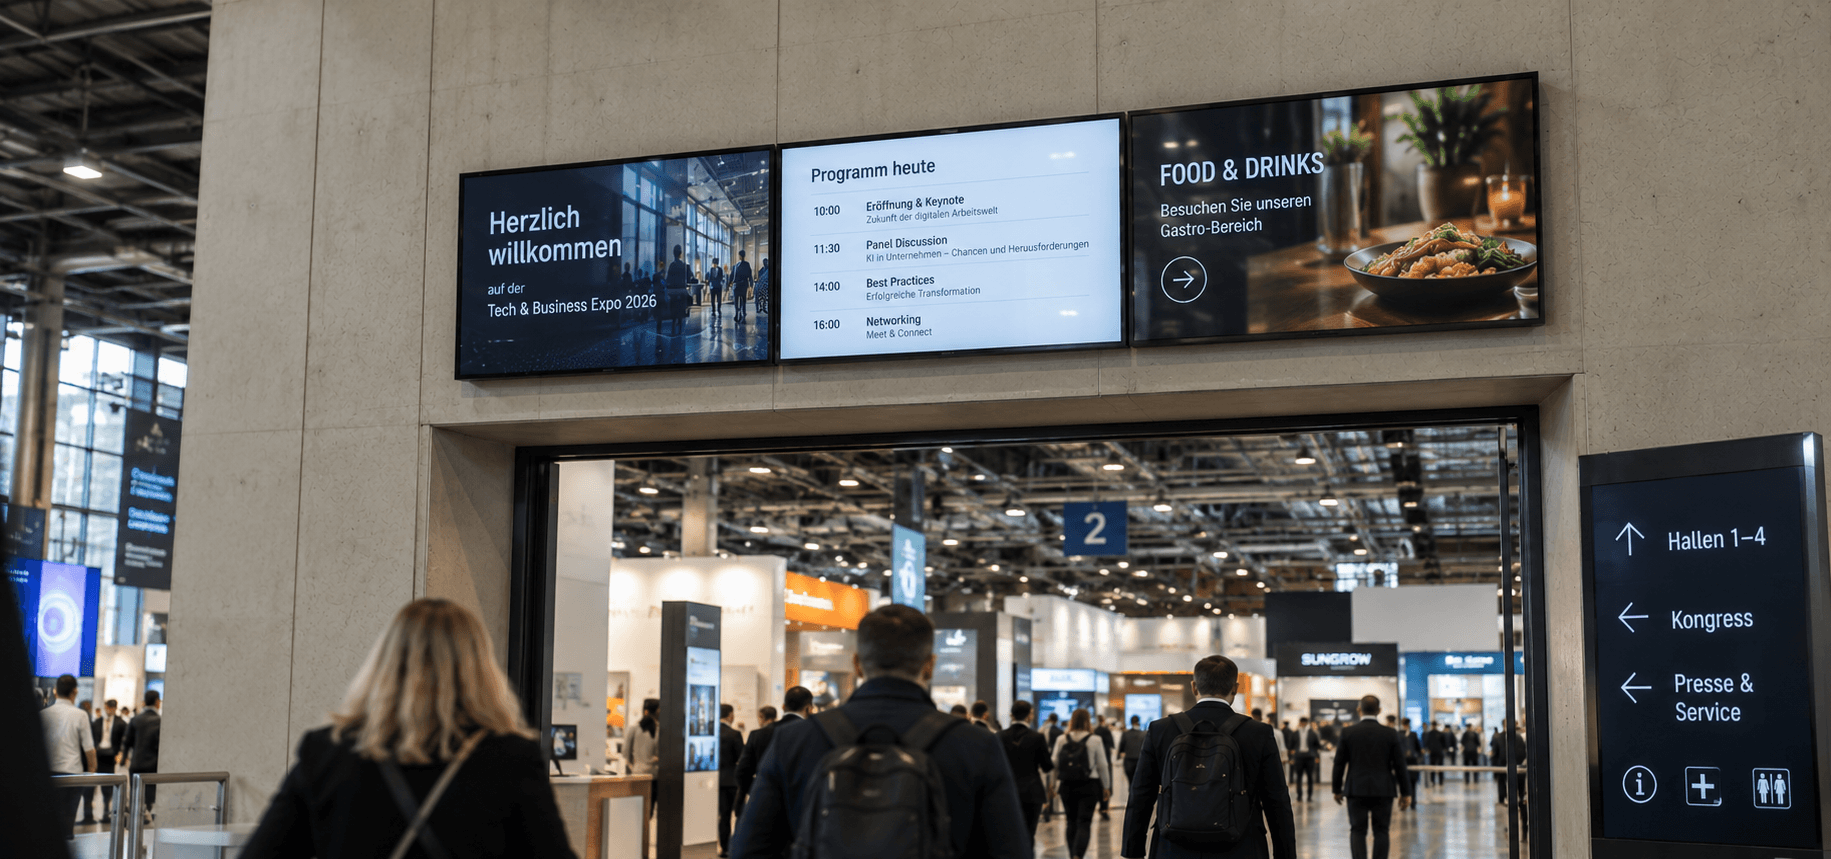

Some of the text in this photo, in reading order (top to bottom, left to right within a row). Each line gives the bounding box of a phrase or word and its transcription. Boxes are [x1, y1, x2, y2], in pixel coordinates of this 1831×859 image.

[811, 160, 935, 184] Programm heute
[1160, 152, 1325, 186] FOOD & DRINKS
[814, 205, 840, 216] 10:00
[867, 194, 965, 211] Eröffnung & Keynote
[1161, 196, 1312, 217] Besuchen Sie unseren
[489, 204, 580, 235] Herzlich
[866, 206, 998, 224] Zukunft der digitalen Arbeitswelt
[1161, 218, 1262, 237] Gastro-Bereich
[814, 243, 840, 254] 11:30
[867, 236, 948, 250] Panel Discussion
[488, 238, 622, 266] willkommen
[886, 251, 942, 261] Unternehmen
[952, 247, 987, 257] Chancen
[990, 246, 1006, 254] und
[488, 282, 525, 296] auf der
[814, 282, 840, 292] 14:00
[866, 275, 934, 288] Best Practices
[918, 286, 980, 298] Transformation
[488, 294, 657, 317] Tech & Business Expo 2026
[814, 320, 840, 330] 16:00
[866, 315, 921, 326] Networking
[866, 328, 932, 339] Meet & Connect
[1084, 513, 1106, 544] 2
[1668, 527, 1766, 551] Hallen 1–4
[1671, 611, 1754, 633] Kongress
[1301, 653, 1372, 666] SUNGROW
[1675, 672, 1754, 693] Presse &
[1675, 701, 1742, 722] Service
